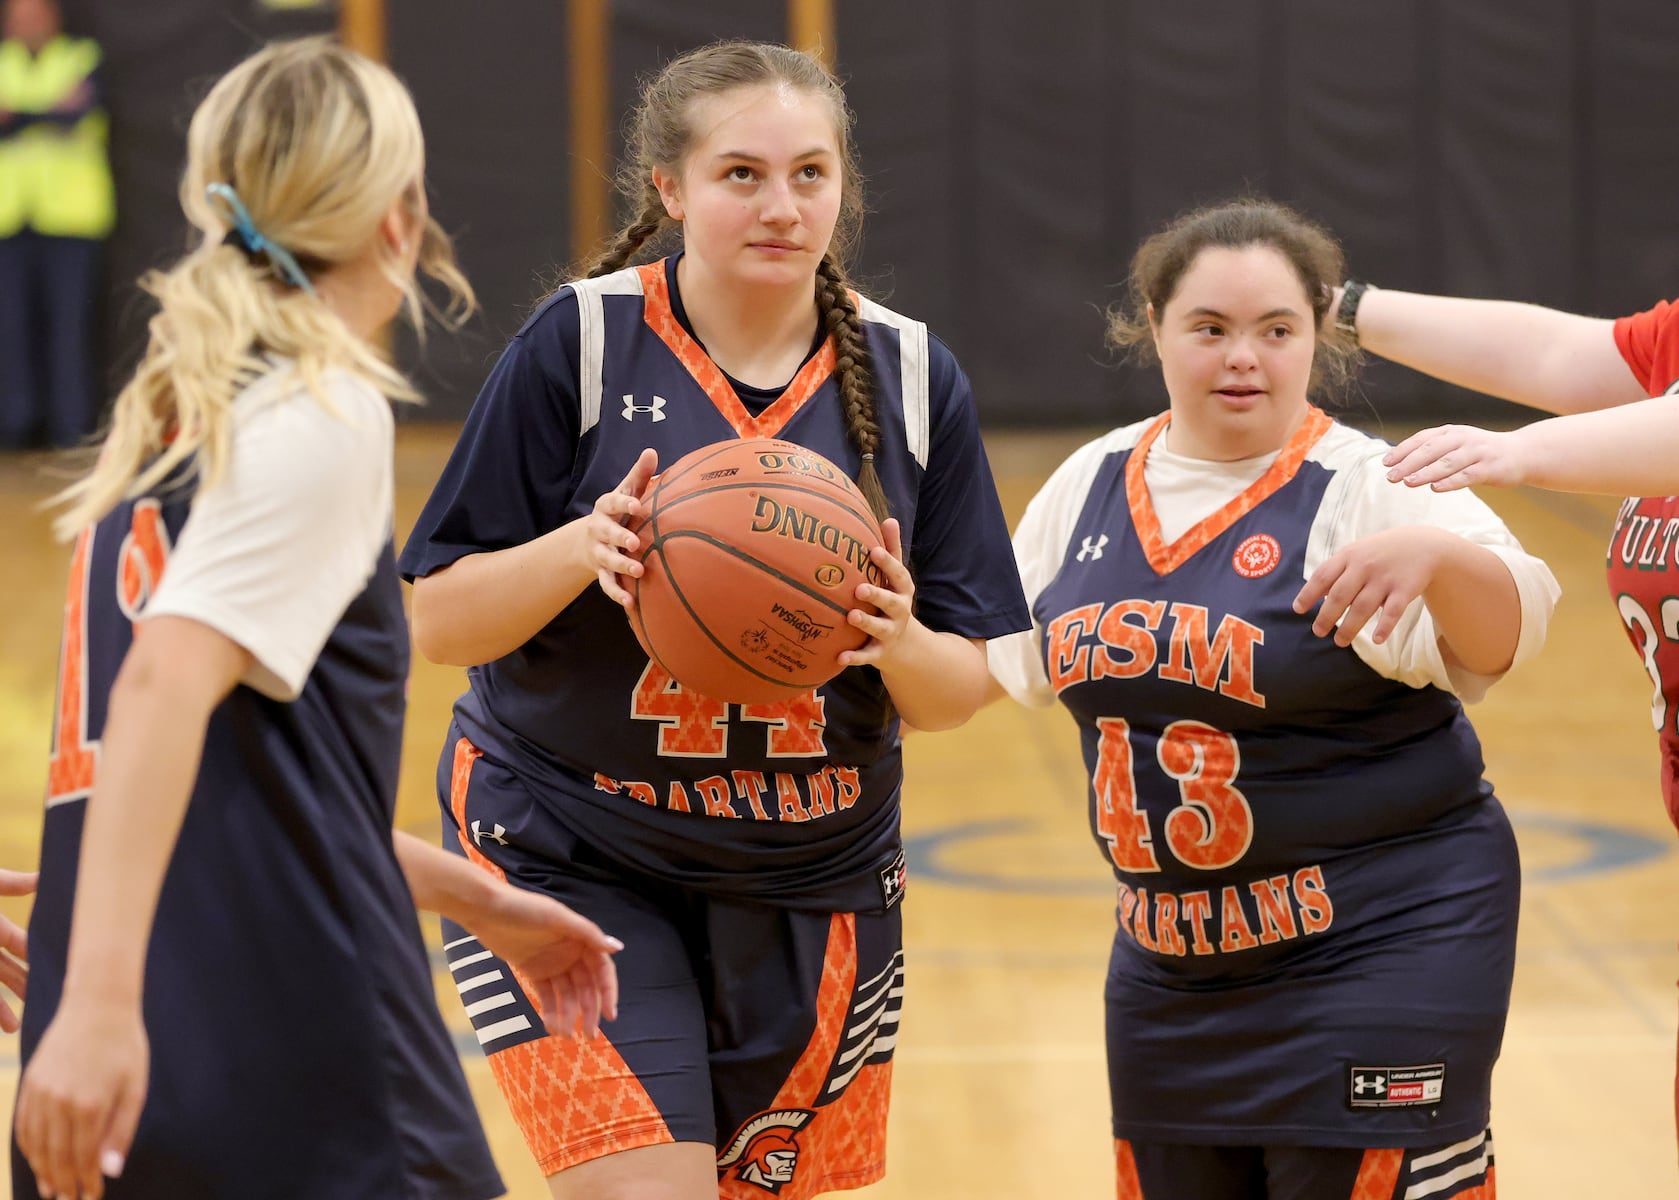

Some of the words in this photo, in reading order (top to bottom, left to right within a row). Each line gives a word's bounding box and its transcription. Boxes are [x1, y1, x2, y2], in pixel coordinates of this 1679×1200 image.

[751, 494, 886, 586] PALDING
[1606, 496, 1679, 568] FULT
[771, 603, 822, 641] NYSPHSAA
[1047, 599, 1266, 708] ESM
[1093, 717, 1254, 873] 43
[1117, 865, 1334, 957] PARTANS
